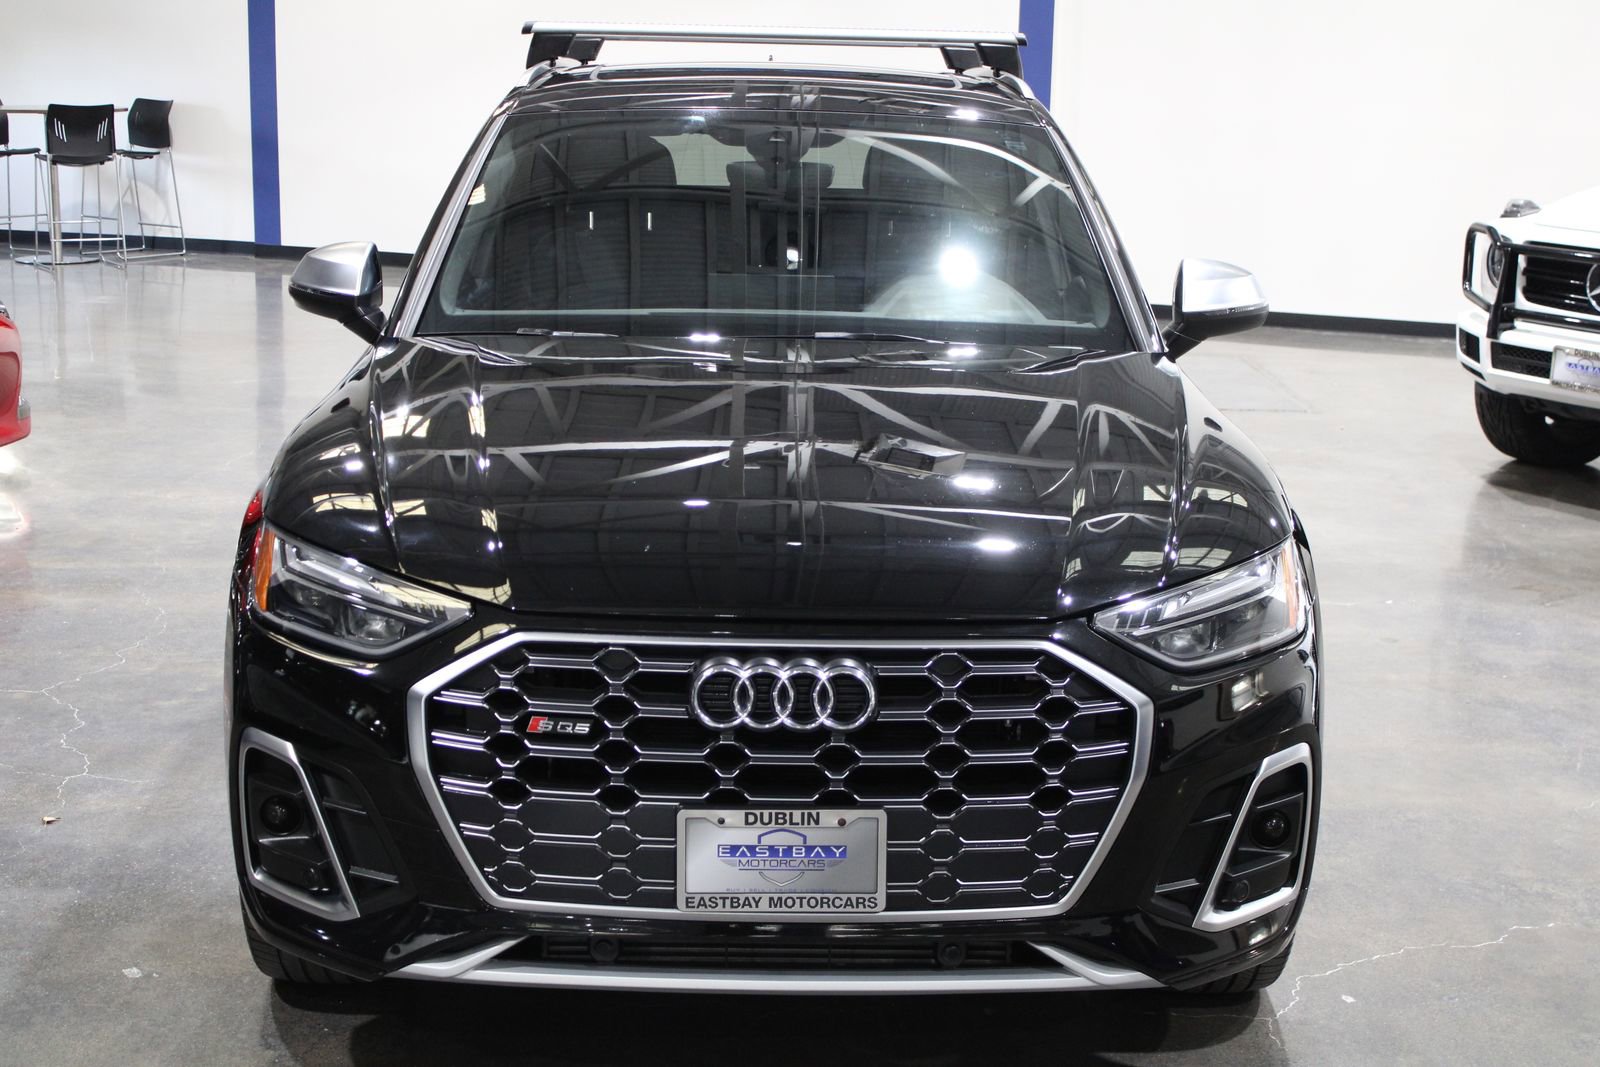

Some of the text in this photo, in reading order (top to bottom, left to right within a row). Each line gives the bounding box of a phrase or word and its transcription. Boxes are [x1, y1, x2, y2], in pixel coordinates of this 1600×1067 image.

[536, 719, 590, 734] SQ5
[744, 811, 820, 826] DUBLIN
[719, 846, 846, 857] EASTBAY
[738, 859, 826, 868] MOTORCARS
[685, 896, 878, 909] EASTBAY MOTORCARS
